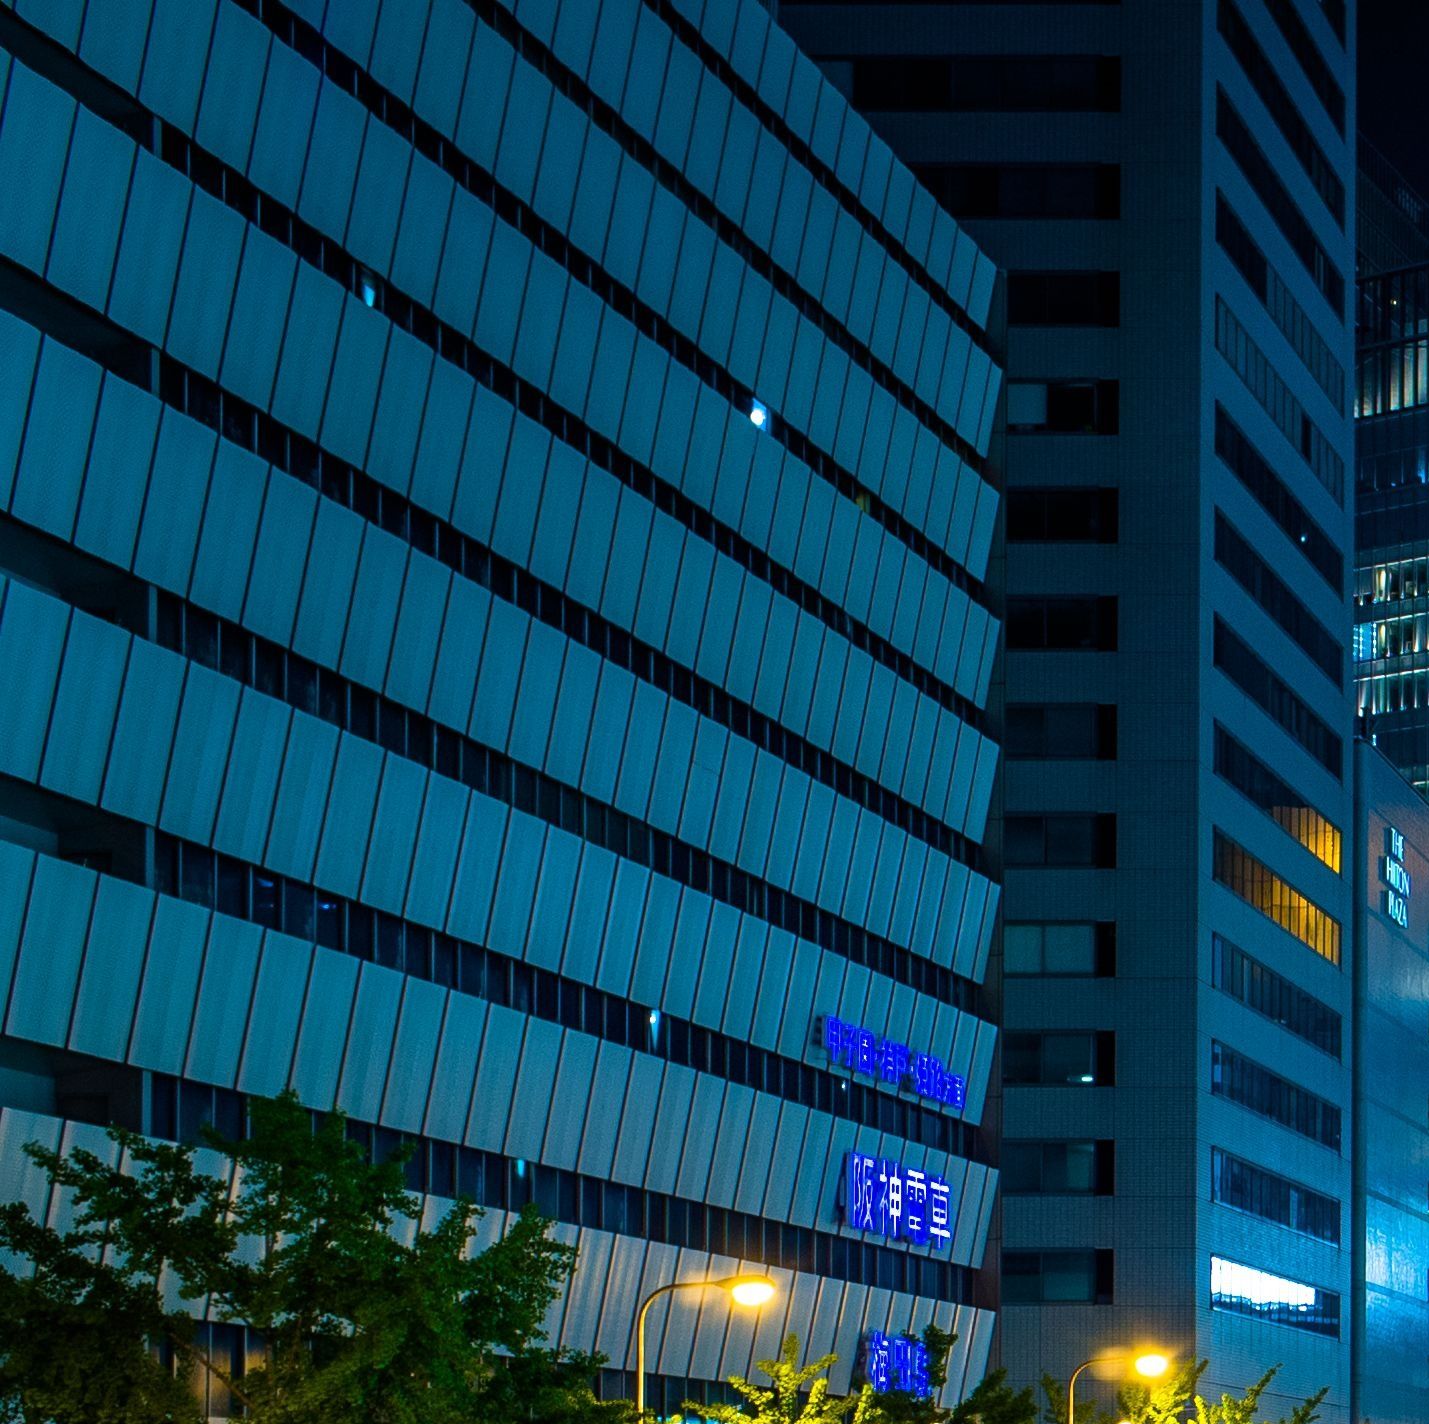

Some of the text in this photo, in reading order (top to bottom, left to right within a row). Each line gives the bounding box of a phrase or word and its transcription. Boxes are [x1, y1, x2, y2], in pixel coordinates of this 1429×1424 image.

[1390, 827, 1404, 862] THE
[1388, 890, 1408, 929] PLAZA
[852, 1152, 951, 1249] 阪神電車
